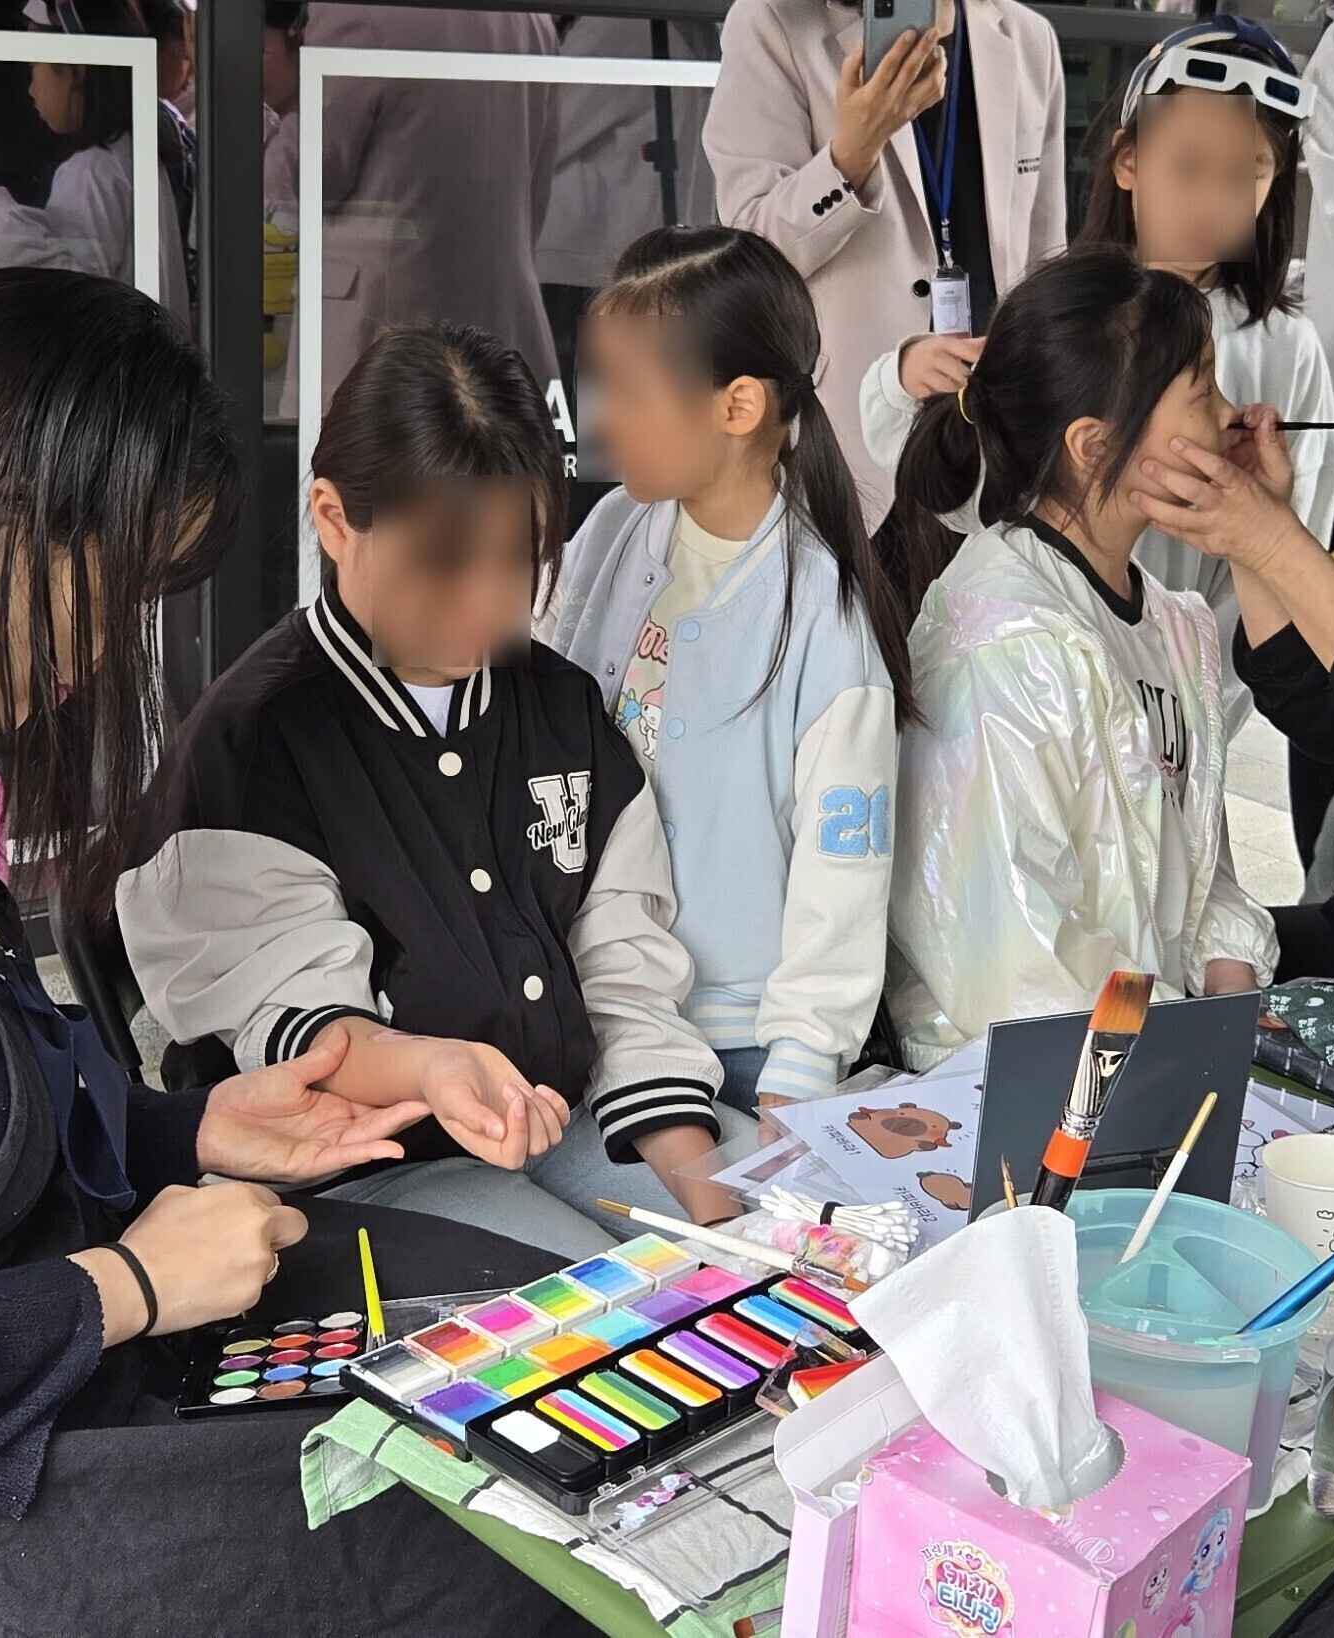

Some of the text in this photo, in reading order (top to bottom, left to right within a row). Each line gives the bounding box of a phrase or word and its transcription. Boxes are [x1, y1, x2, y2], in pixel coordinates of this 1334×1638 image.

[820, 1124, 862, 1156] 카피바라1
[892, 1185, 939, 1223] 카피바라2
[943, 1562, 997, 1602] 캐치!
[938, 1584, 1002, 1632] 티니핑
